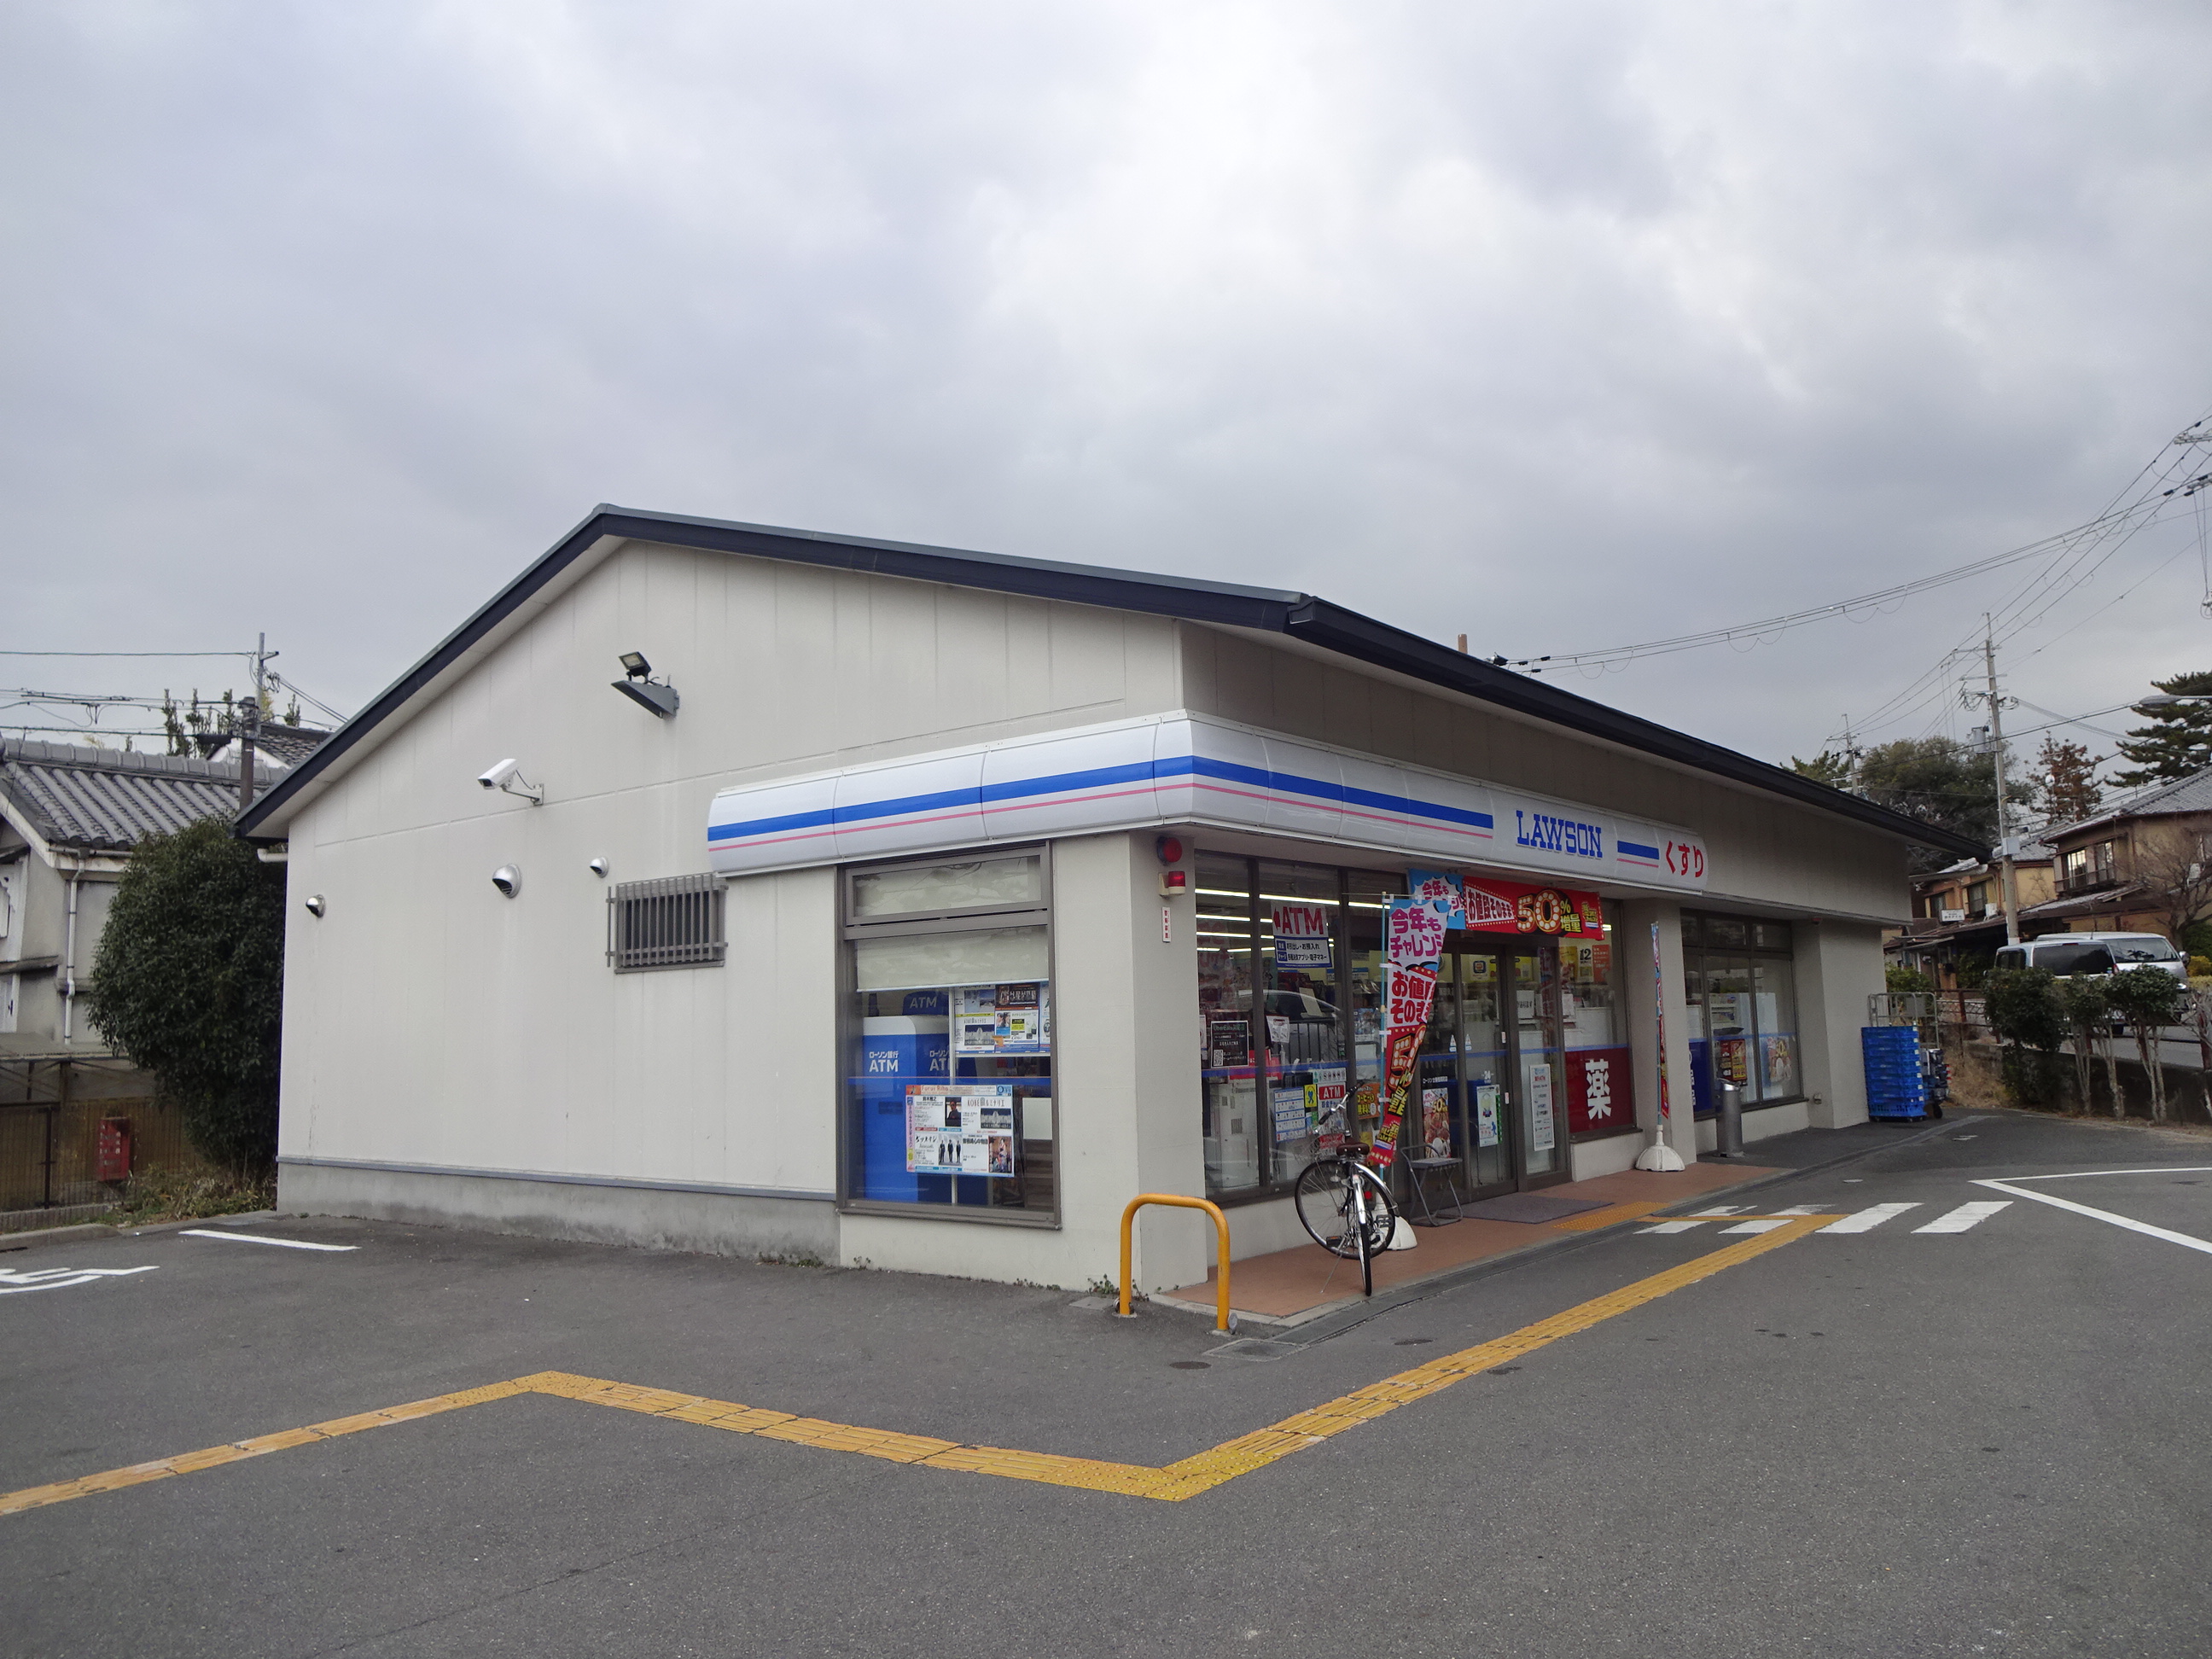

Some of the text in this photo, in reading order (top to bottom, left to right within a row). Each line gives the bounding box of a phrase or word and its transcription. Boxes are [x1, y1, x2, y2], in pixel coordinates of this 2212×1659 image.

[1516, 810, 1604, 859] LAWSON
[1666, 841, 1705, 878] くすり
[1282, 906, 1324, 934] ATM
[1391, 907, 1442, 934] 今年も
[1580, 948, 1591, 961] 12
[910, 997, 937, 1009] ATM
[869, 1060, 899, 1072] ATM
[929, 1058, 951, 1071] AT
[1324, 1086, 1341, 1098] ATM
[1585, 1058, 1612, 1120] 薬
